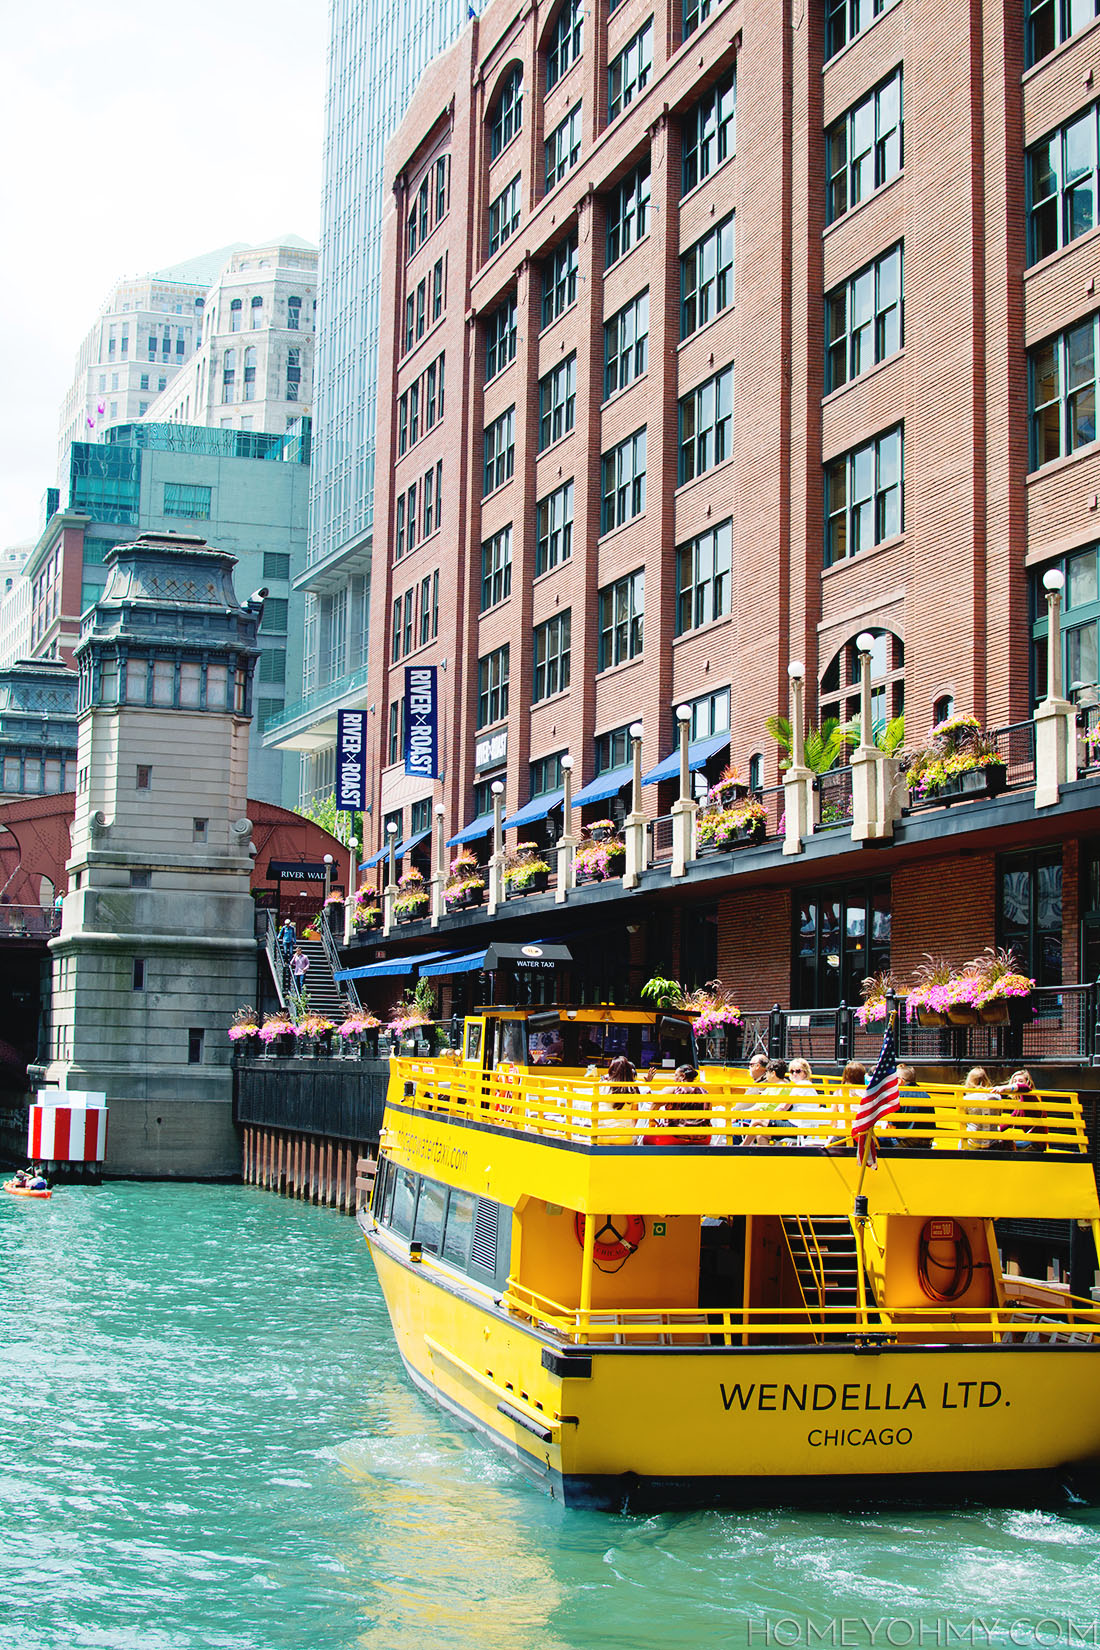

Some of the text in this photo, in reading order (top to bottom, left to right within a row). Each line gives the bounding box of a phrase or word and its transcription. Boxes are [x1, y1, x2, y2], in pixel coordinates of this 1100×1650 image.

[410, 669, 432, 714] RIVER
[342, 713, 362, 753] RIVER
[410, 726, 433, 775] ROAST
[341, 763, 362, 808] ROAST
[516, 960, 540, 968] WATER
[719, 1381, 1011, 1411] WENDELLA LTD.
[807, 1427, 913, 1447] CHICAGO
